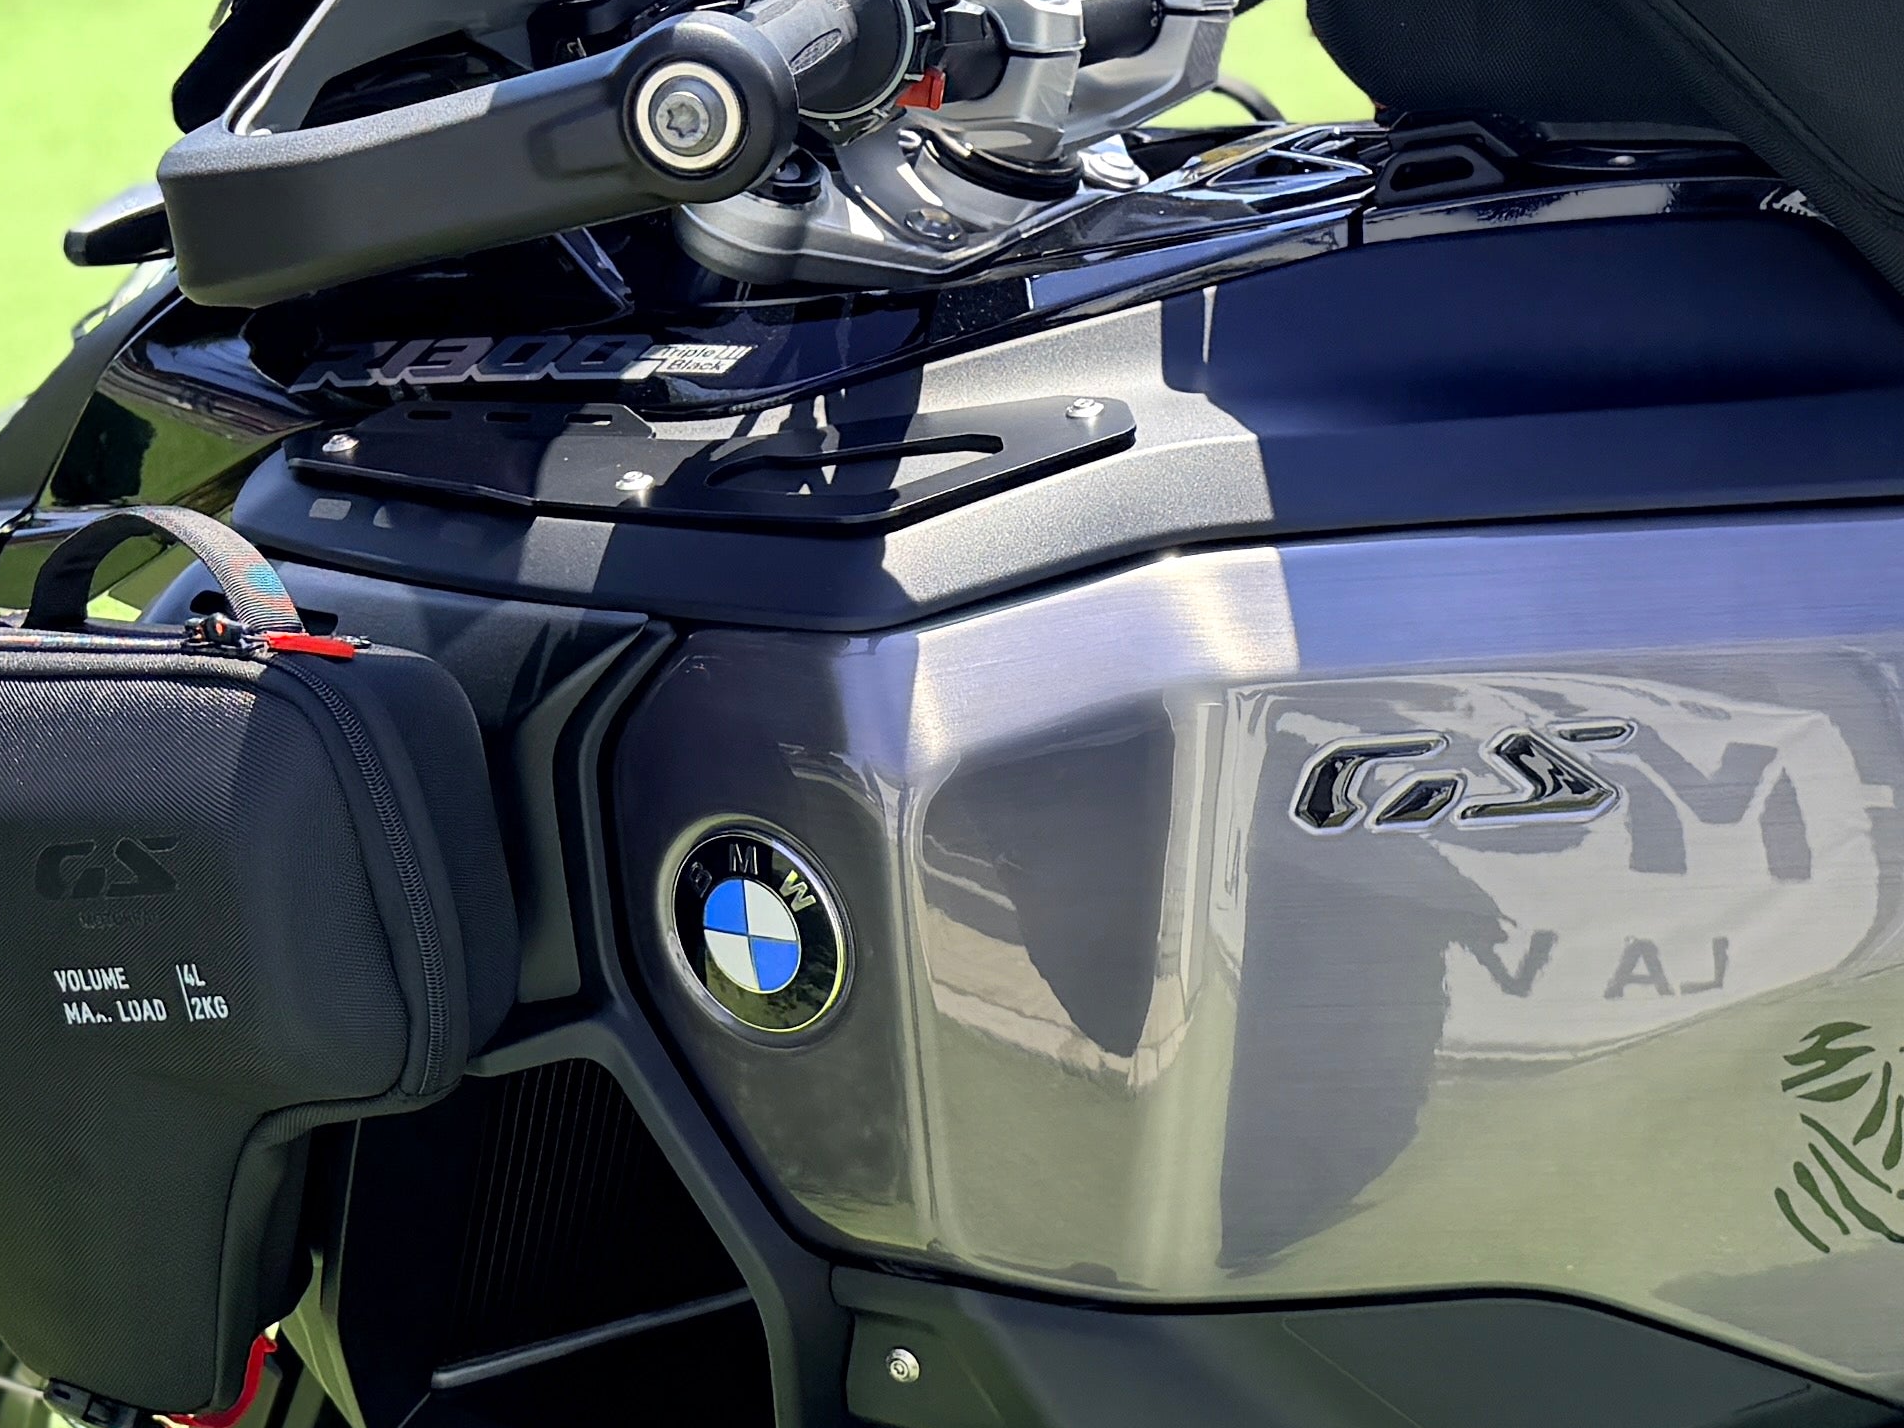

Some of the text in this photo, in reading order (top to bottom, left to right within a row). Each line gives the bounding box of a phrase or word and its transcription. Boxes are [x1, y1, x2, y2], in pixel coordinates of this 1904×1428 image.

[666, 359, 725, 371] Black
[1290, 716, 1638, 836] GS
[34, 833, 182, 901] GS
[688, 842, 817, 913] BMW
[53, 963, 206, 993] VOLUME 4L
[116, 998, 167, 1023] LOAD
[191, 995, 229, 1021] 2KG
